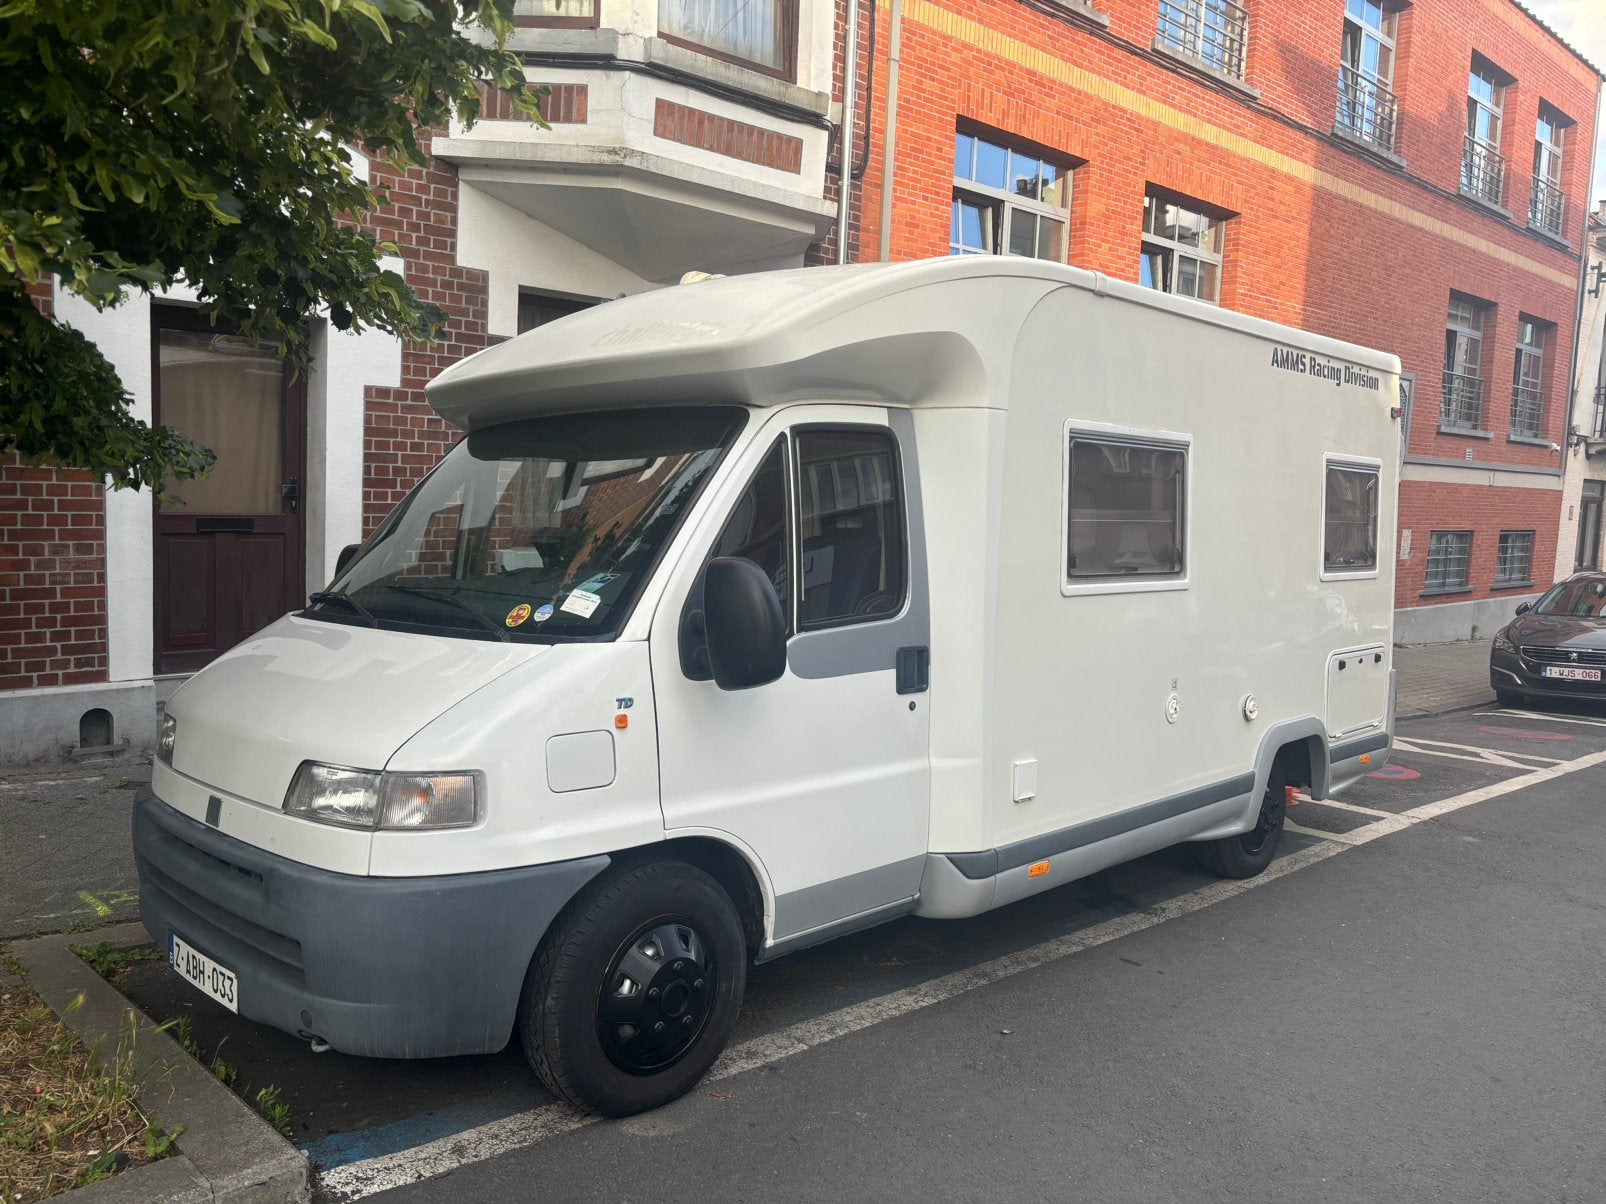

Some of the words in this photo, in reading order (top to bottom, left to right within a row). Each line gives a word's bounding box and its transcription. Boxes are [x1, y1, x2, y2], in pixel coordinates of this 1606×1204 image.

[1271, 347, 1306, 374] AMMS
[1309, 356, 1342, 387] Racing
[1344, 365, 1379, 391] Division
[615, 697, 634, 710] TD
[175, 942, 234, 1004] Z-ABH-033
